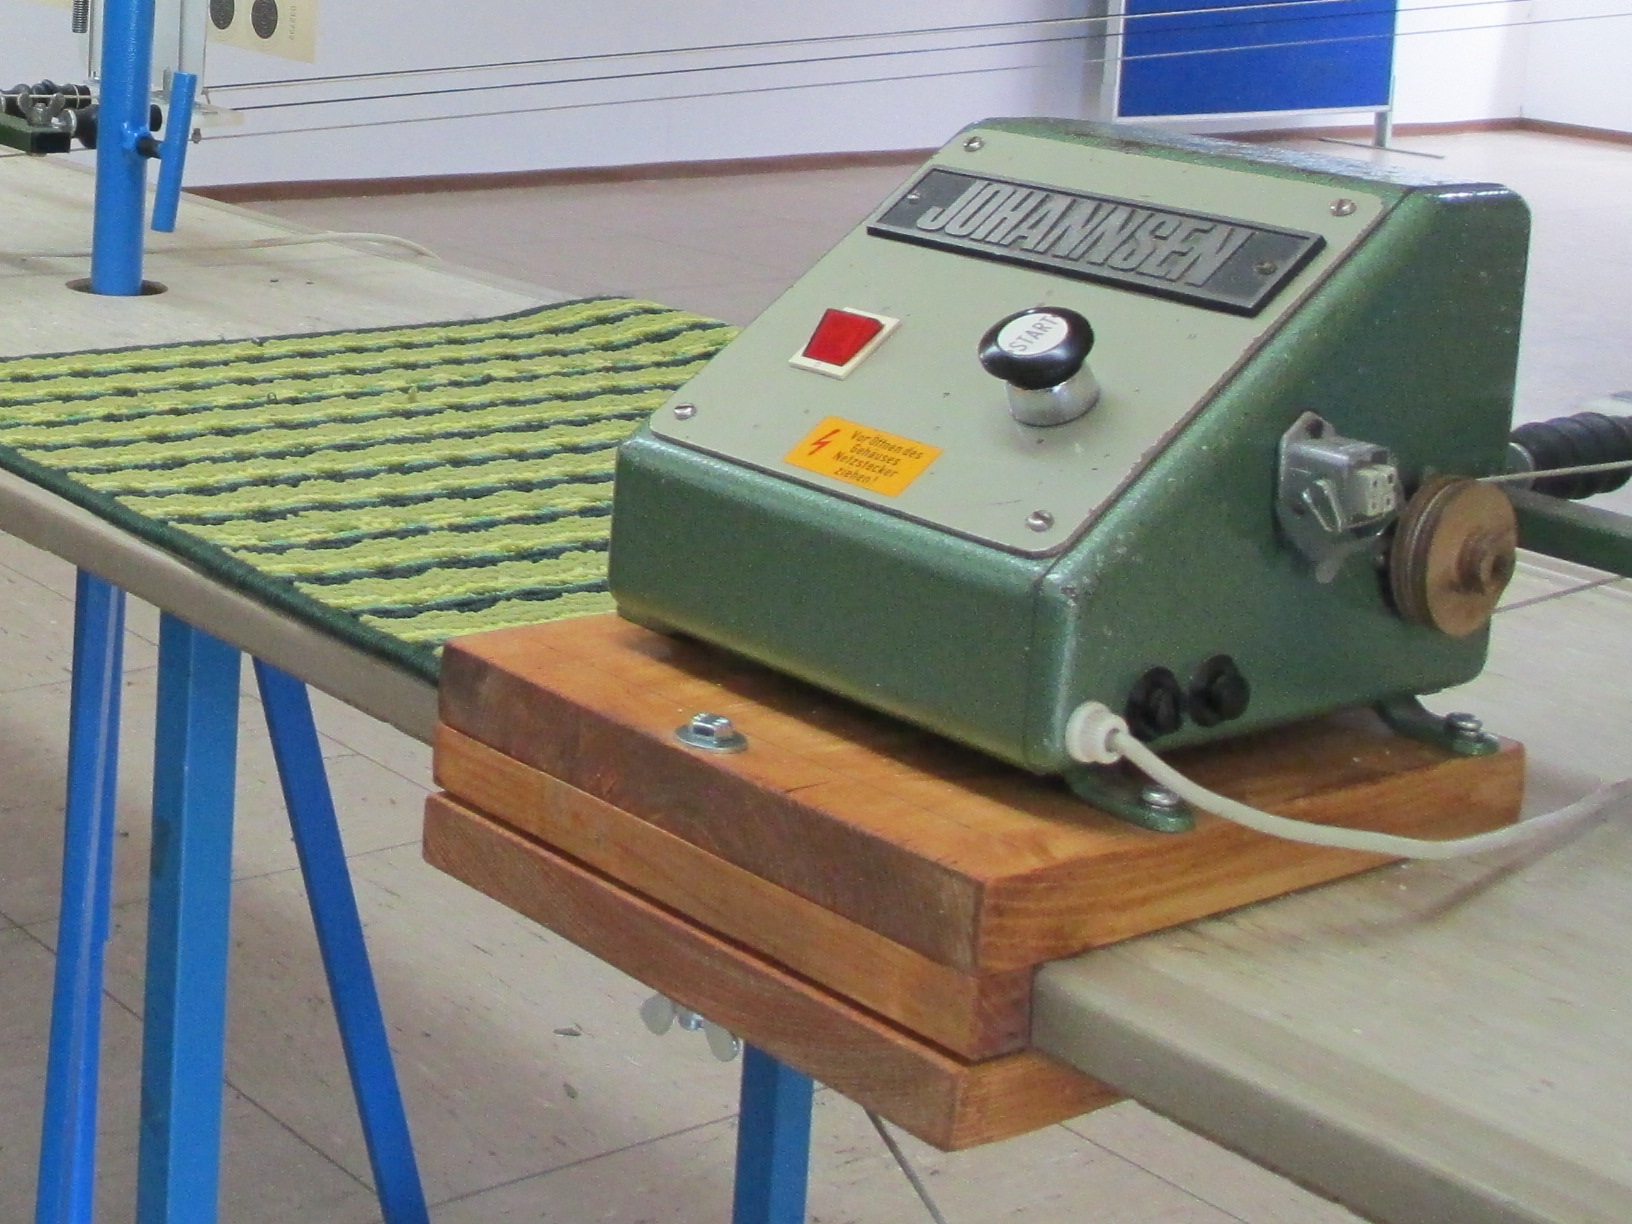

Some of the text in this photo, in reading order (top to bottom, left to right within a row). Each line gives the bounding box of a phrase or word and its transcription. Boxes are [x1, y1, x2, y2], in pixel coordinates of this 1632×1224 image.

[916, 178, 1255, 287] JOHANNSEN
[1009, 316, 1058, 351] START
[851, 430, 870, 443] Vor
[902, 445, 924, 460] des
